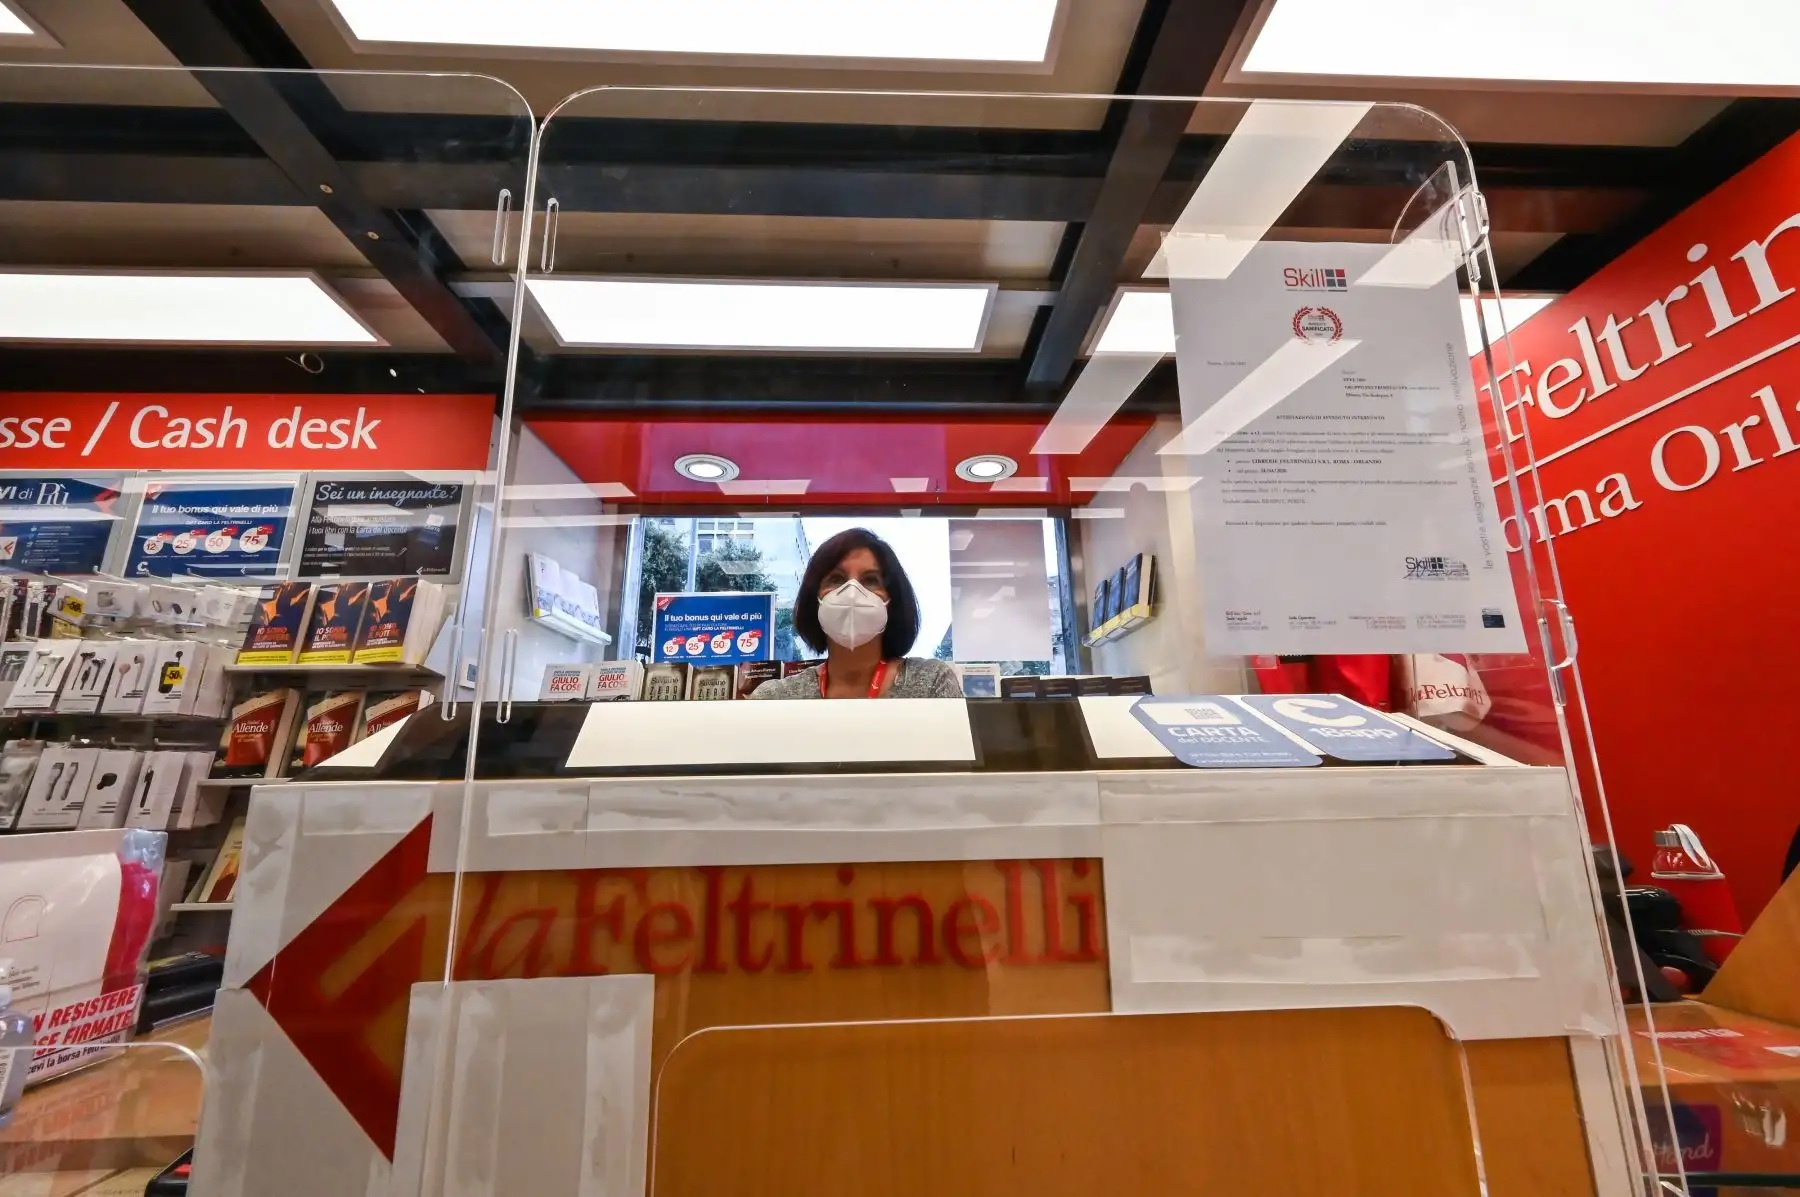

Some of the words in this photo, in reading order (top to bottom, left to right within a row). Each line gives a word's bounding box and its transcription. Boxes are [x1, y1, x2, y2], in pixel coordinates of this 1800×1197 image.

[1284, 267, 1326, 288] Skill
[129, 404, 248, 450] Cash
[267, 406, 382, 451] desk
[1499, 470, 1644, 554] oma
[1650, 384, 1800, 492] Orl
[18, 487, 34, 499] di
[316, 484, 344, 501] Sei
[347, 489, 366, 499] un
[369, 483, 458, 506] insegnante?
[178, 505, 212, 513] bonus
[212, 505, 228, 515] qui
[229, 505, 249, 513] vale
[251, 505, 260, 513] di
[262, 504, 278, 514] più
[175, 540, 189, 549] 25
[208, 538, 223, 547] 50
[244, 536, 259, 545] 75
[684, 613, 708, 621] bonus
[710, 613, 722, 622] qui
[740, 612, 748, 620] di
[750, 612, 762, 622] più
[713, 640, 725, 648] 50
[740, 638, 752, 647] 75
[599, 674, 625, 682] GIULIO
[232, 722, 268, 732] Allende
[308, 722, 343, 732] Allende
[1167, 726, 1261, 737] CARTA
[1308, 727, 1399, 740] 18app
[1200, 736, 1272, 744] DOCENTE
[48, 987, 137, 1029] RESISTERE
[33, 1031, 61, 1057] SE
[62, 1010, 134, 1046] FIRMATE
[46, 1058, 55, 1068] la
[57, 1050, 81, 1064] borsa
